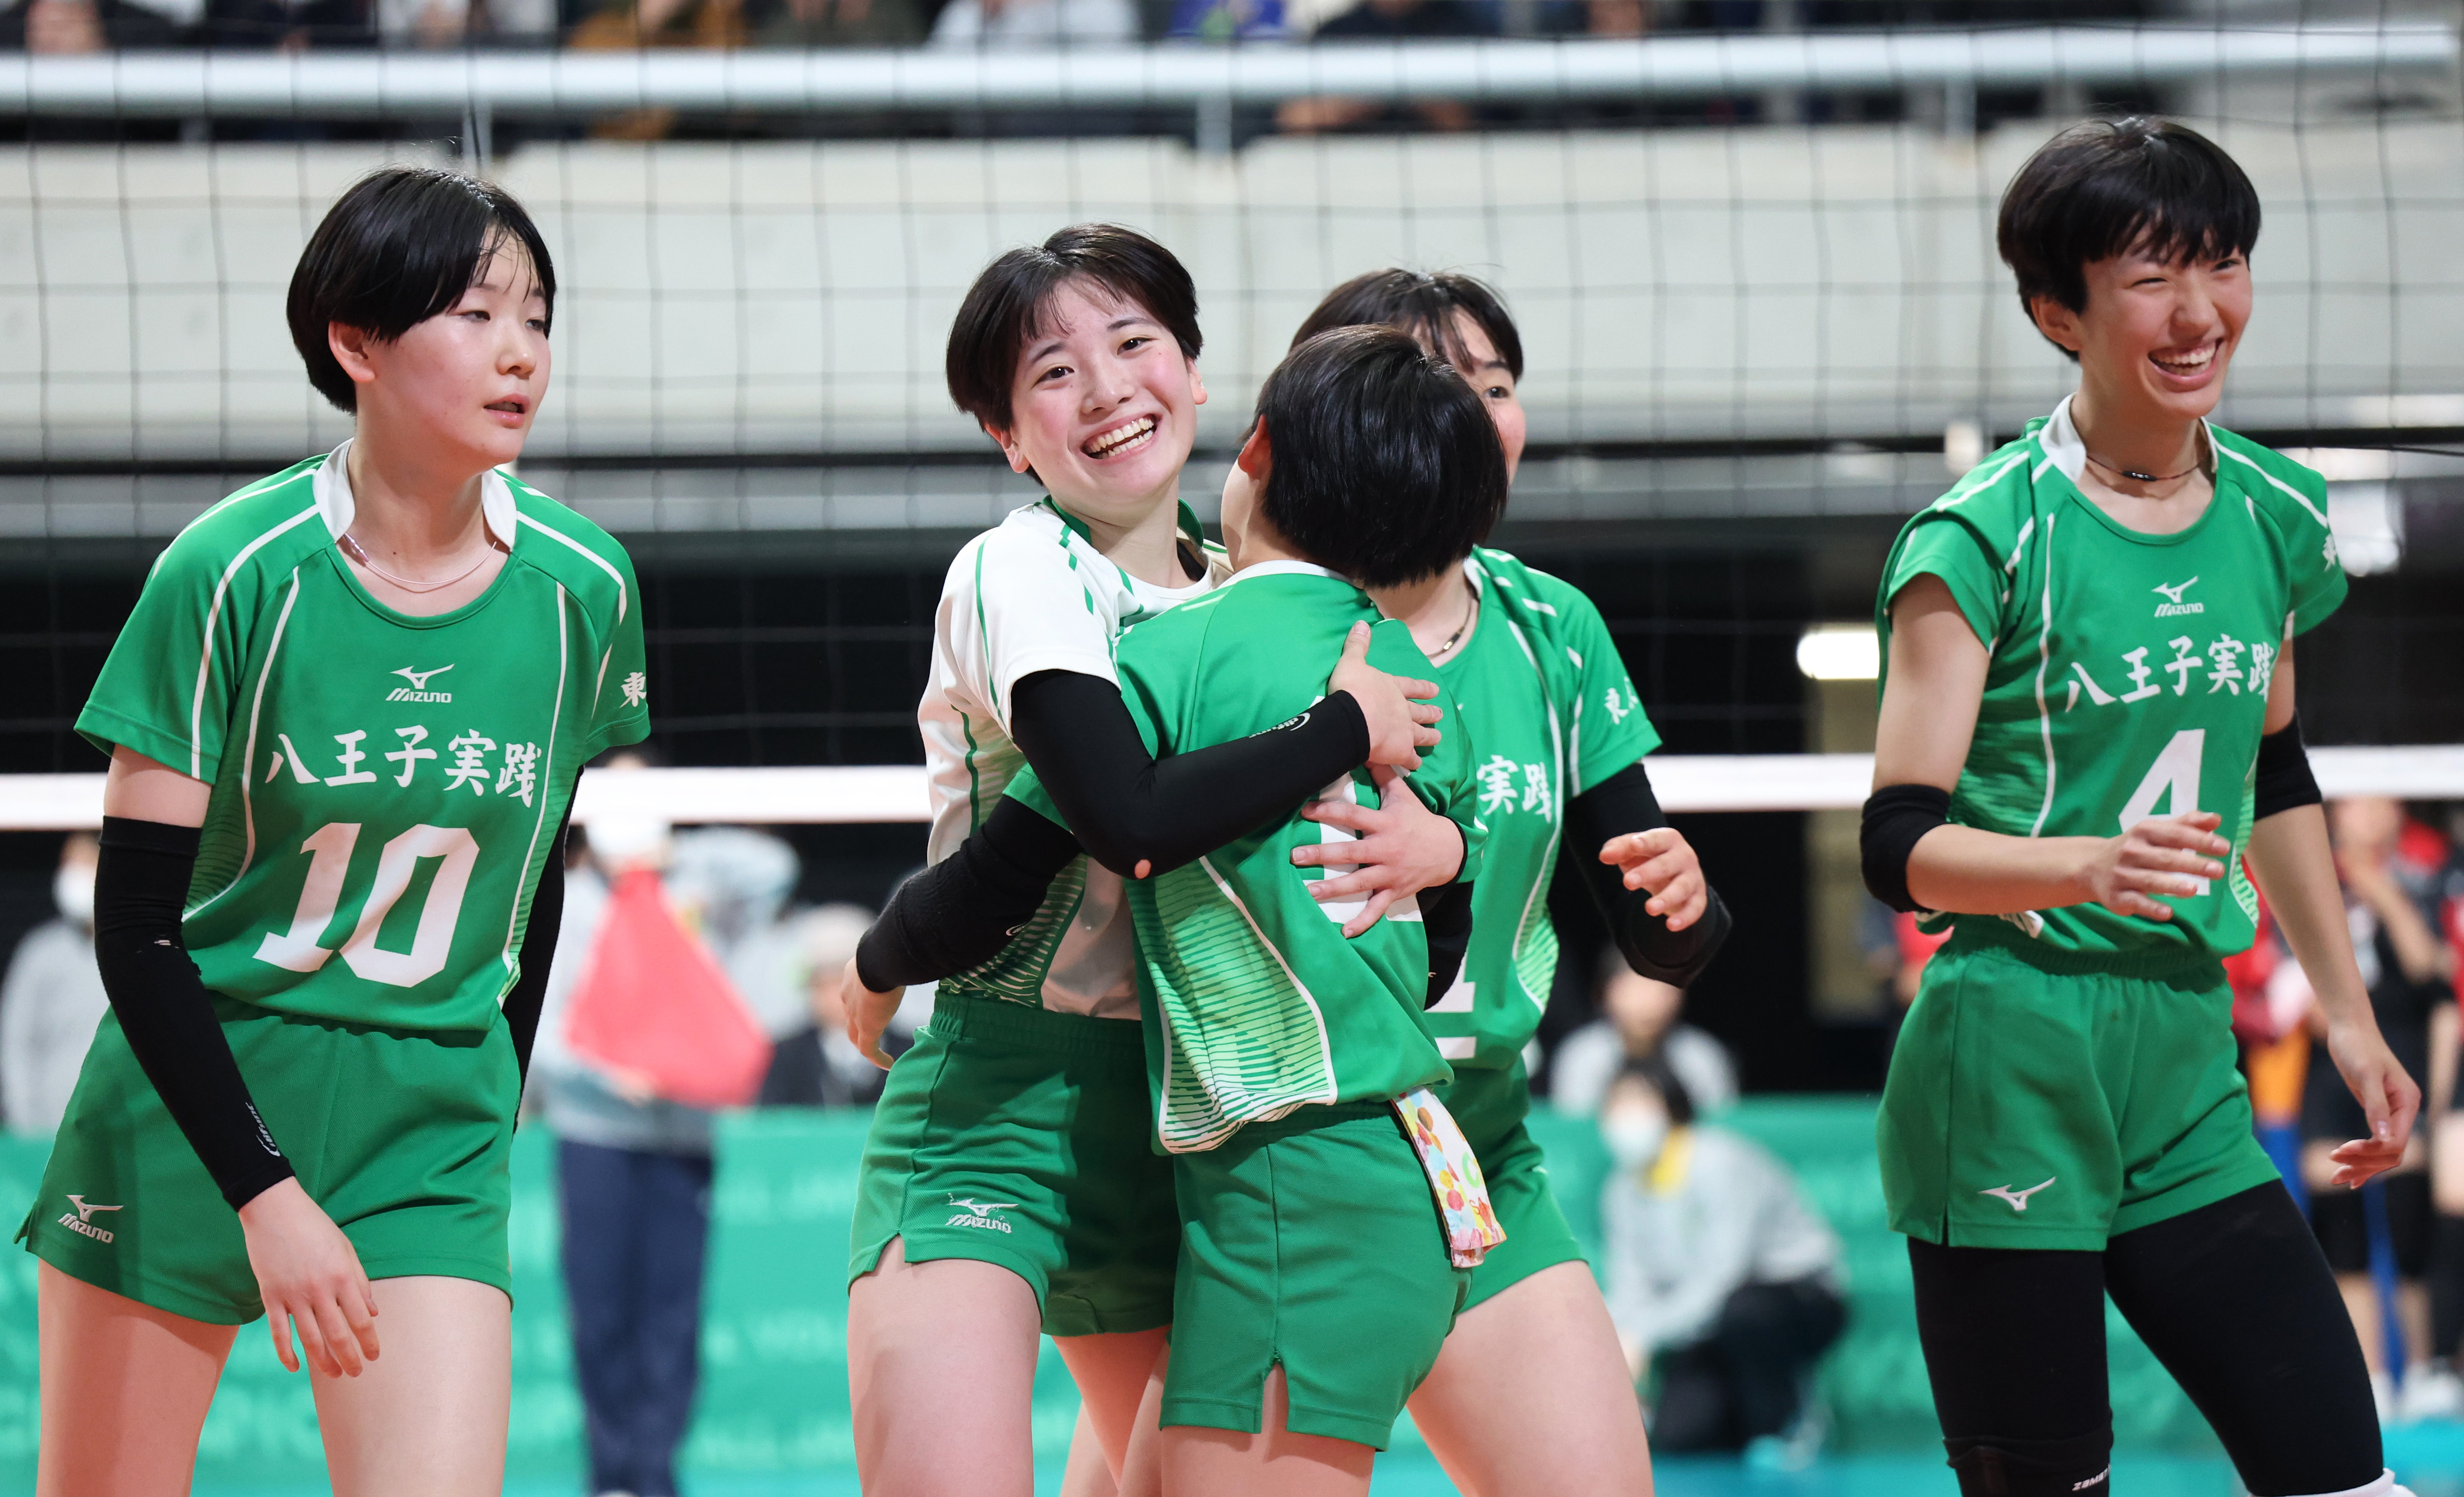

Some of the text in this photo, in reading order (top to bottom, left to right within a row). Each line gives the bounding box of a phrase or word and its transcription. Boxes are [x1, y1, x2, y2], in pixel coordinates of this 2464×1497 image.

[2153, 602, 2205, 618] MIZUNO
[385, 687, 452, 703] MIZUNO
[619, 672, 647, 708] 東
[264, 724, 543, 808] 八王子実践
[2118, 728, 2210, 896] 4
[252, 822, 480, 988] 10
[57, 1213, 114, 1243] MIZUNO
[944, 1214, 1012, 1234] MIZUNO
